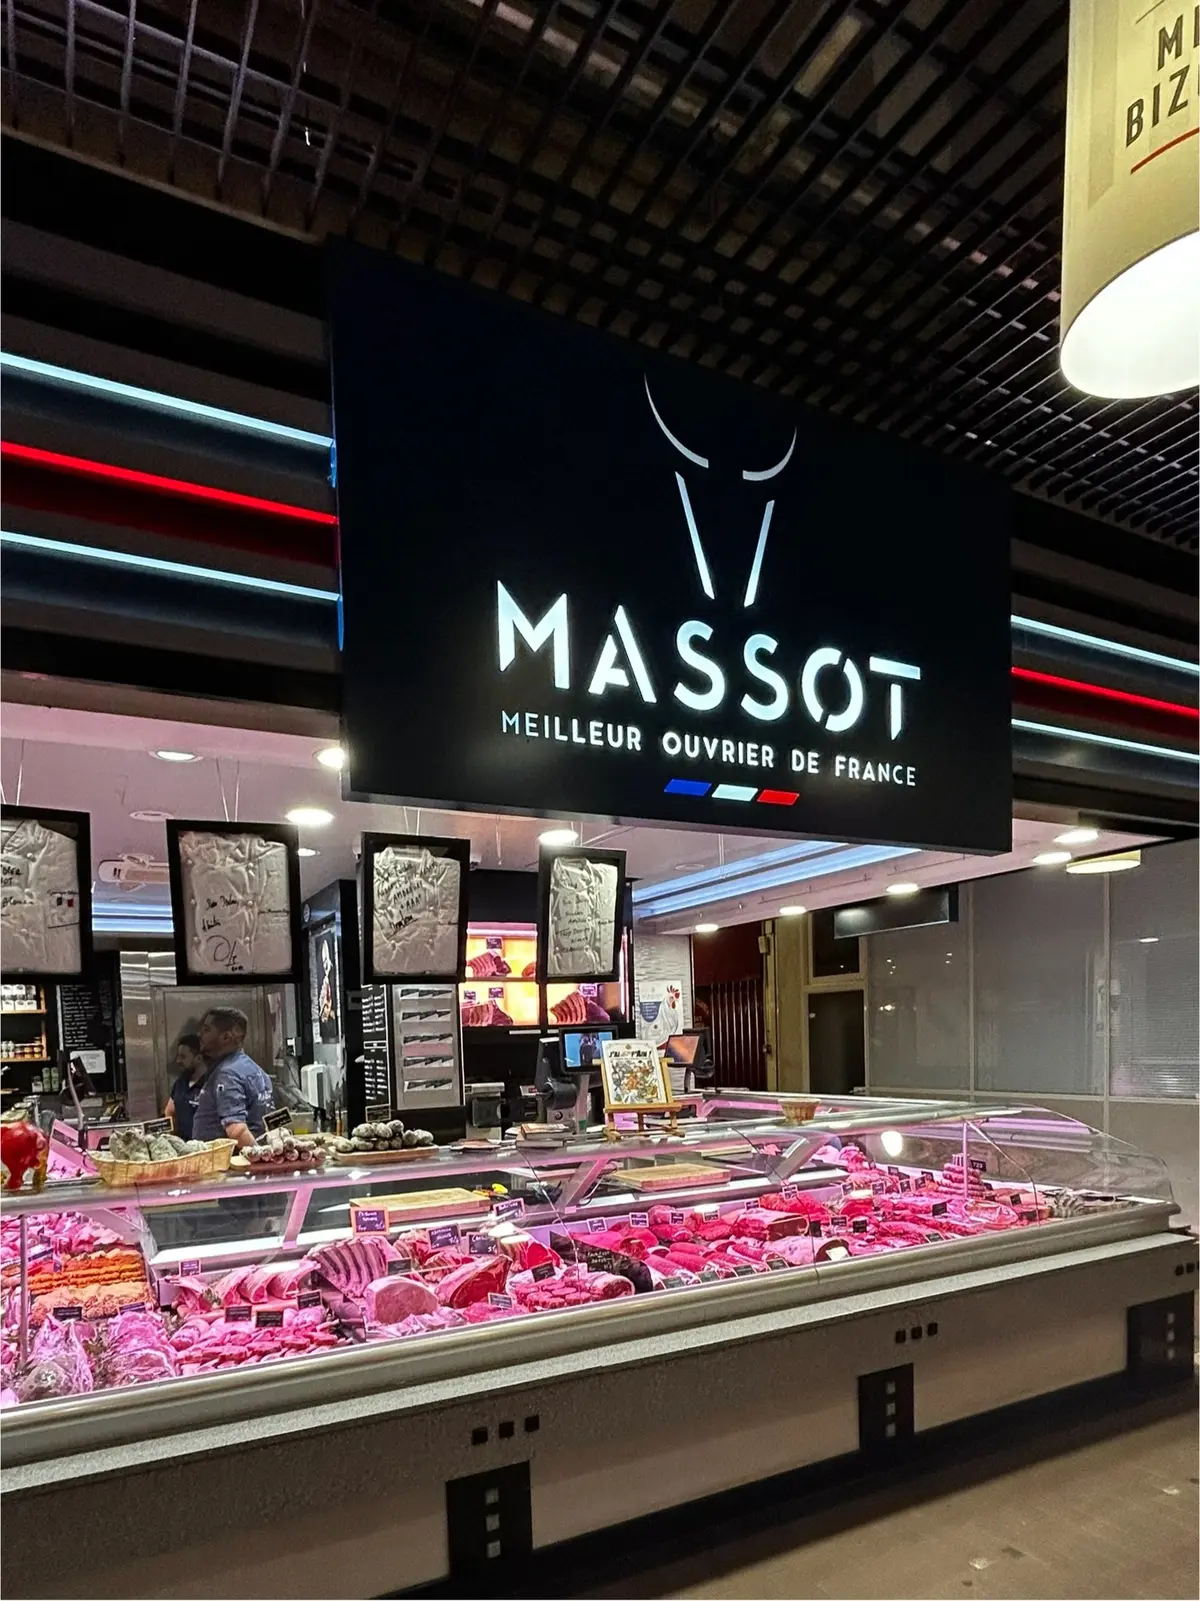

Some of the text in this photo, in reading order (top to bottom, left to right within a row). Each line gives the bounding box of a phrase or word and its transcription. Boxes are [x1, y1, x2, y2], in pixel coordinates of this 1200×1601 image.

[1126, 65, 1199, 148] BIZ
[497, 580, 921, 741] MASSOT
[501, 709, 917, 788] MEILLEUR OUVRIER DE FRANCE
